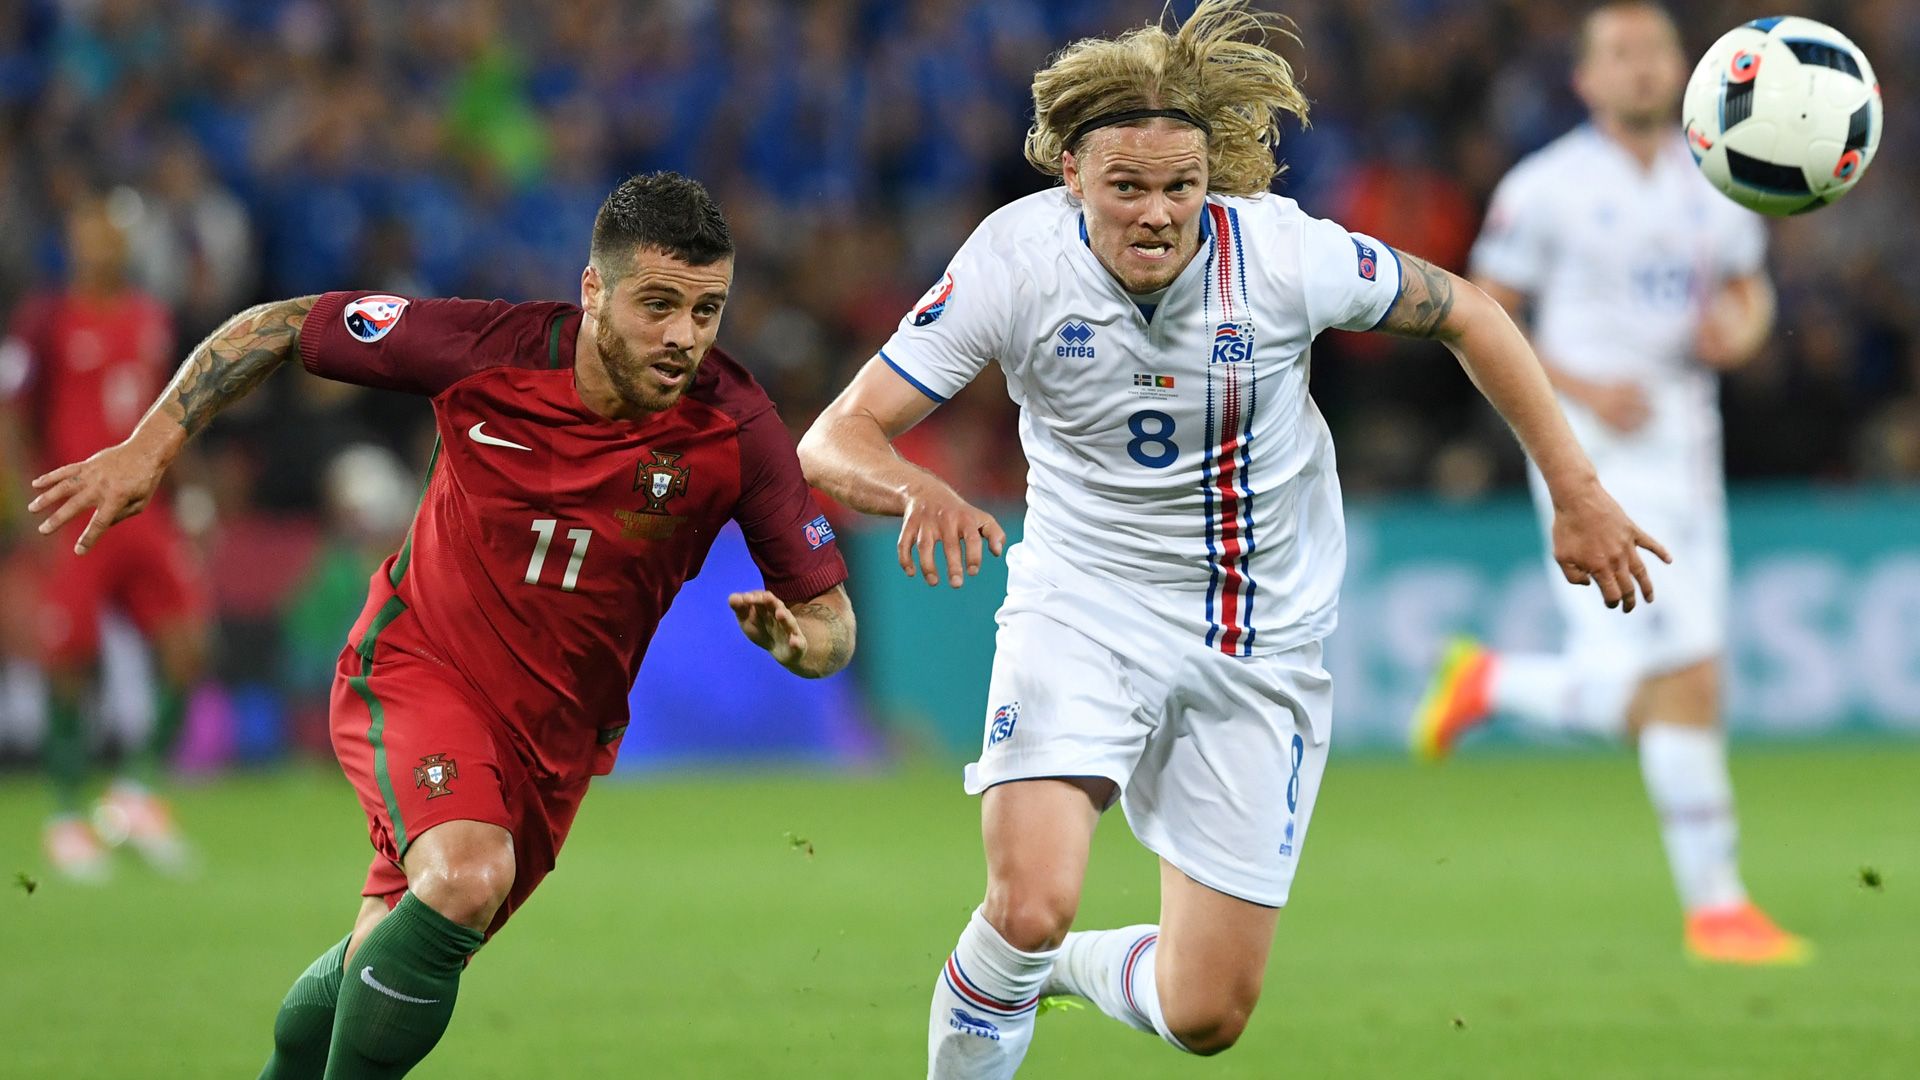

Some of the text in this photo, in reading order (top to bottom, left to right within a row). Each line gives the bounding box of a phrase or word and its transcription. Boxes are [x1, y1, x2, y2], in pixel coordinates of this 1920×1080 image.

[1127, 409, 1180, 469] 8
[524, 519, 593, 592] 11
[816, 521, 833, 537] RE
[1286, 733, 1304, 815] 8
